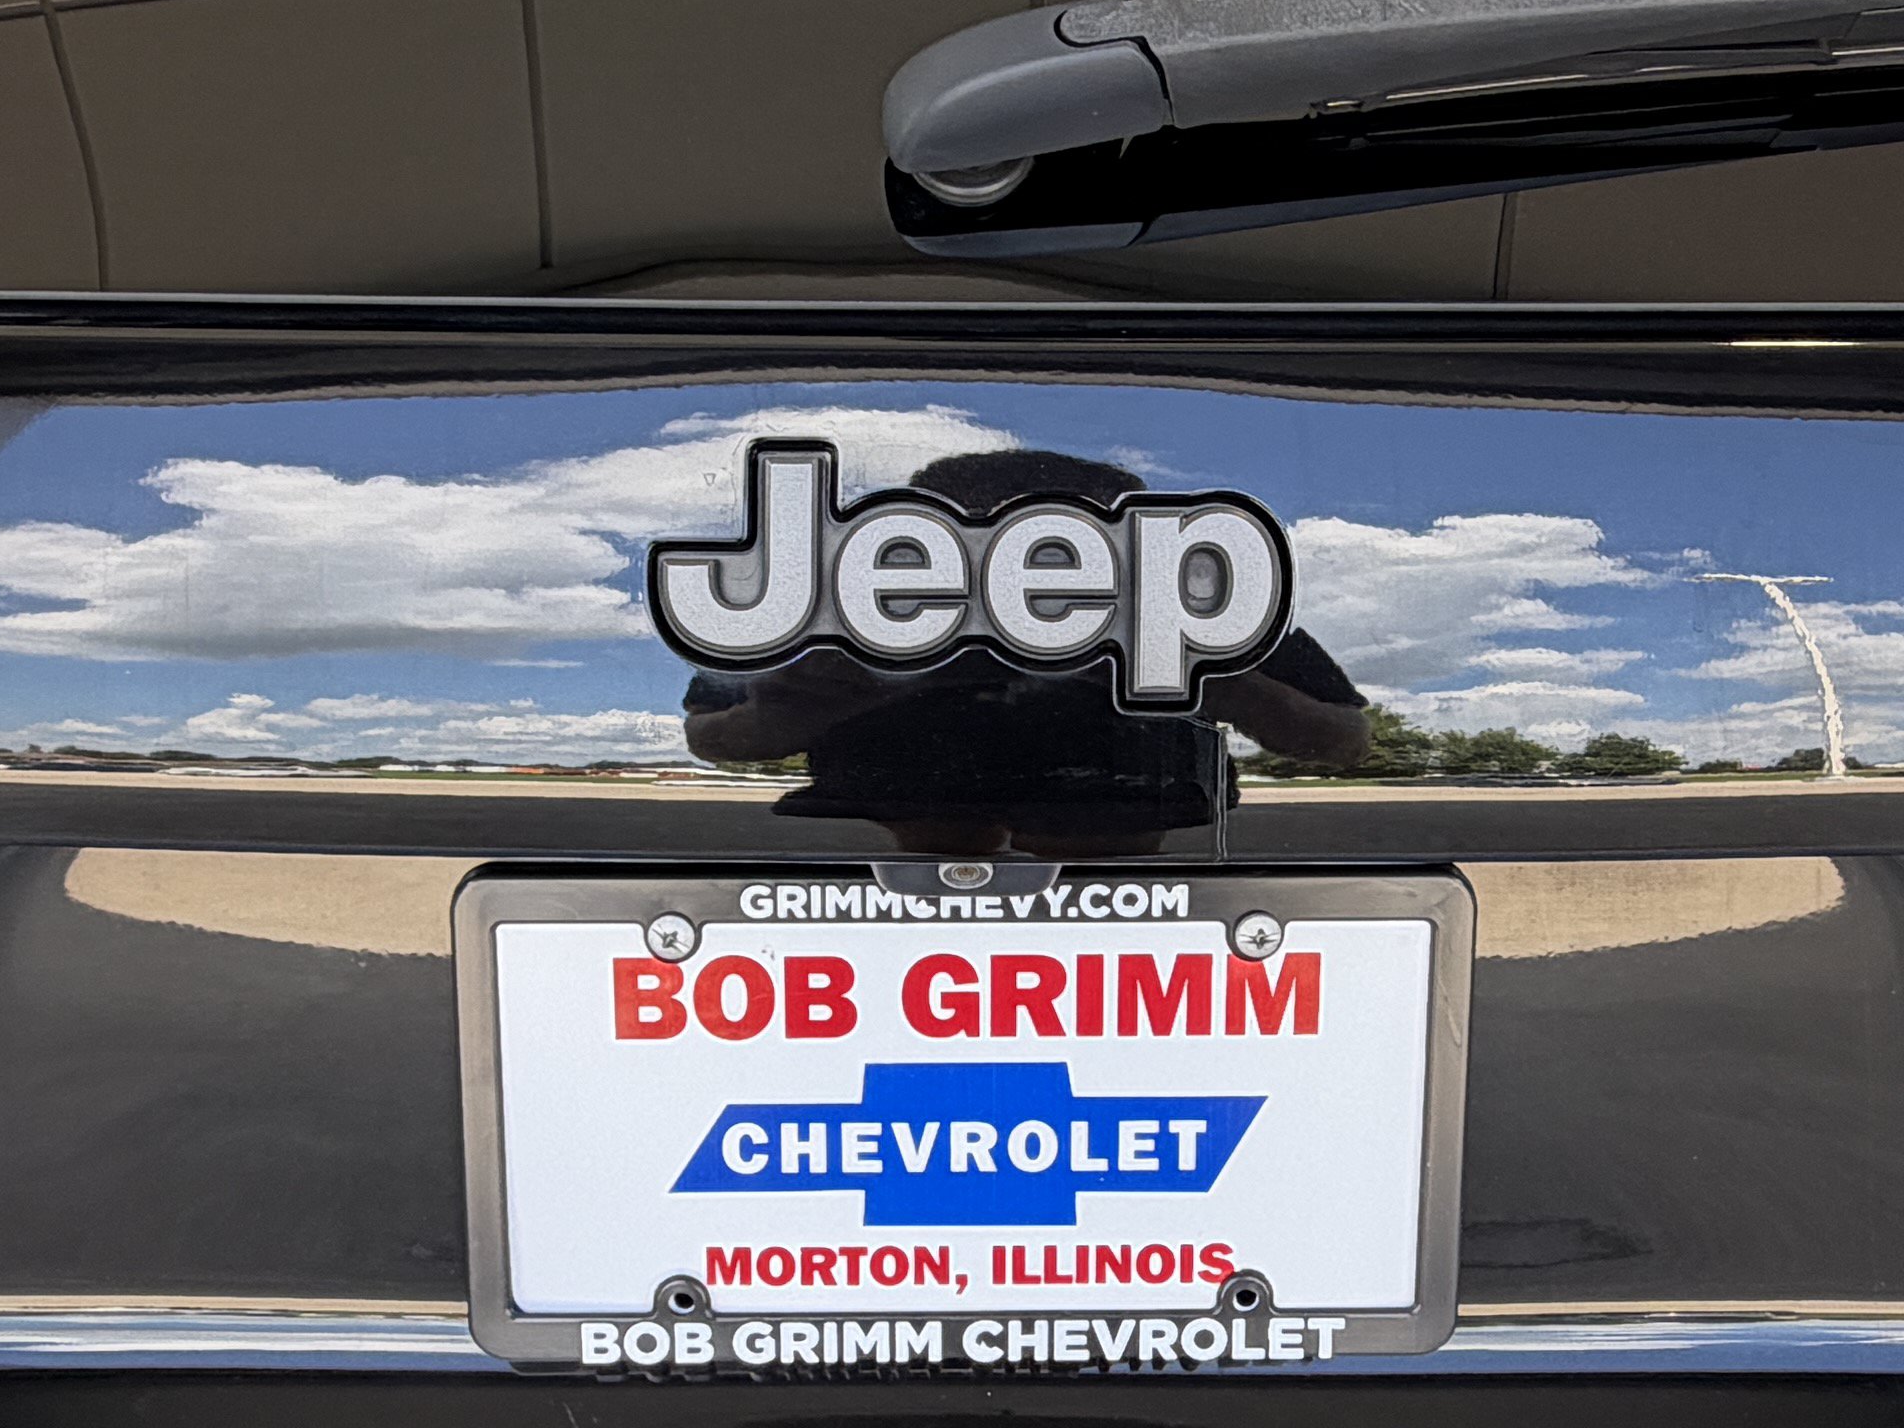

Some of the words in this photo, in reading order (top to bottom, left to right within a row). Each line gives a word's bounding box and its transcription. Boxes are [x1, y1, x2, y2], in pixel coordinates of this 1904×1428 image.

[656, 450, 1286, 698] Jeep
[739, 883, 1190, 920] GRIMMCHEVY.COM
[612, 953, 857, 1042] BOB
[900, 951, 1320, 1039] GRIMM
[721, 1118, 1209, 1174] CHEVROLET
[703, 1245, 969, 1295] MORTON,
[991, 1241, 1236, 1285] ILLINOIS
[579, 1320, 716, 1367] BOB
[732, 1320, 944, 1366] GRIMM
[962, 1316, 1348, 1364] CHEVROLET
